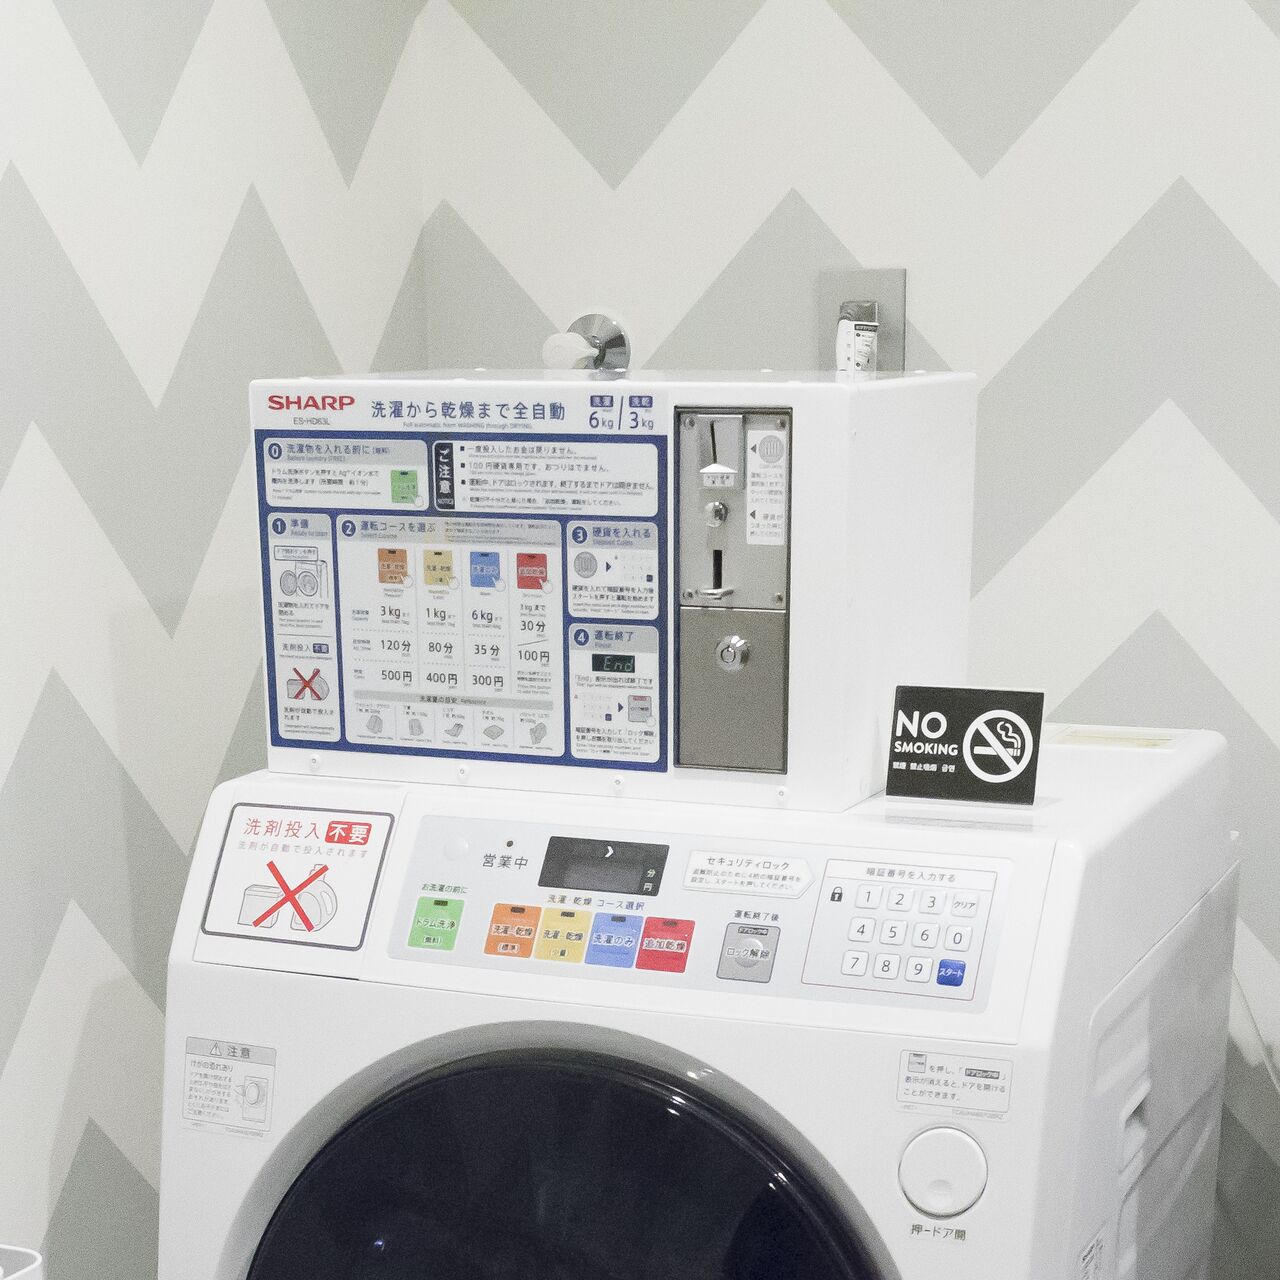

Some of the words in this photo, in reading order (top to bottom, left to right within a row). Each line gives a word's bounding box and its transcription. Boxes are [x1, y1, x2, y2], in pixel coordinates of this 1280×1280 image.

[268, 395, 355, 411] SHARP
[371, 400, 565, 421] 洗濯から乾燥まで全自動
[287, 443, 370, 455] 洗濯物を入れる前に
[438, 448, 451, 494] ご注意
[290, 518, 309, 529] 準備
[360, 520, 436, 532] 運転コースを選ぶ
[592, 526, 651, 539] 硬貨を入れる
[594, 630, 634, 642] 運転終了
[603, 656, 634, 672] End
[896, 709, 948, 739] NO
[894, 741, 959, 756] SMOKING
[243, 816, 320, 840] 洗剤投入
[329, 823, 370, 844] 不要
[238, 840, 369, 858] 洗剤が自動で投入されます
[482, 853, 529, 870] 営業中
[706, 855, 790, 871] セキュリティロック
[646, 868, 656, 878] 分
[866, 866, 956, 884] 暗証番号を入力する
[421, 881, 469, 895] お洗濯の前に
[643, 882, 653, 892] 円
[596, 898, 646, 912] コース選択
[895, 893, 905, 906] 2
[927, 896, 936, 909] 3
[952, 900, 976, 912] クリア
[733, 909, 780, 923] 運転終了後
[415, 918, 456, 930] ドラム洗浄
[593, 933, 635, 947] 洗濯のみ
[856, 923, 866, 937] 4
[888, 925, 897, 939] 5
[920, 928, 929, 942] 6
[644, 937, 687, 952] 追加乾燥
[726, 947, 770, 961] ロック解除
[850, 957, 860, 970] 7
[881, 960, 891, 974] 8
[914, 963, 923, 977] 9
[938, 967, 964, 980] スタート
[903, 1089, 961, 1101] ことができます。
